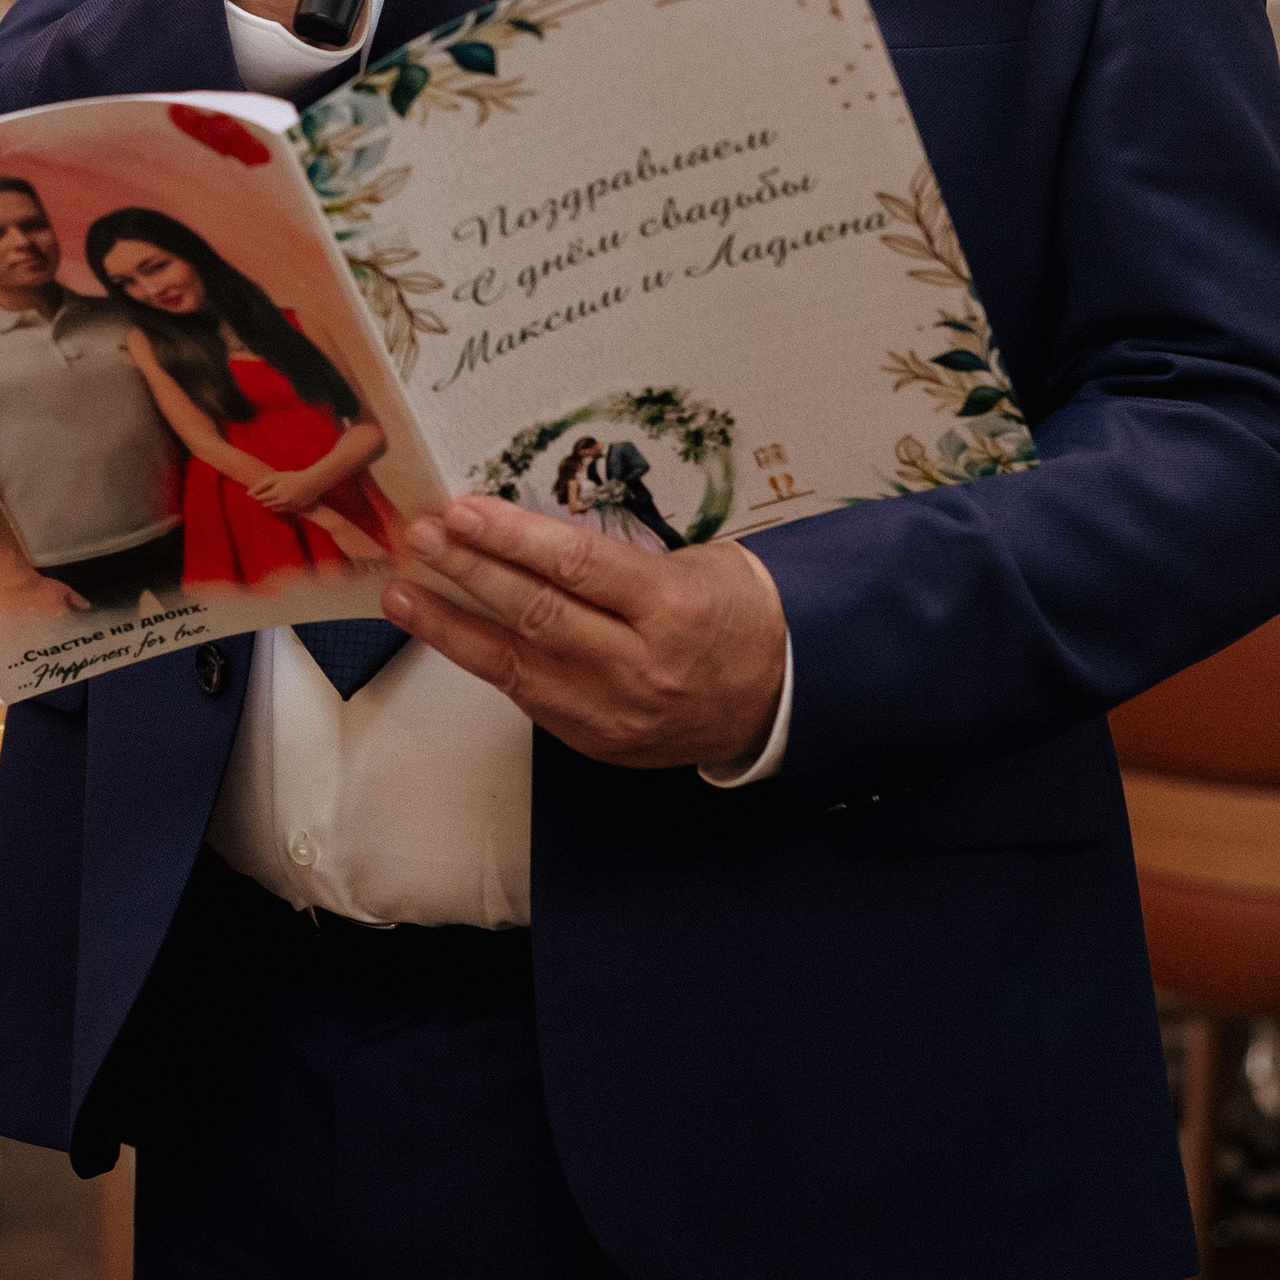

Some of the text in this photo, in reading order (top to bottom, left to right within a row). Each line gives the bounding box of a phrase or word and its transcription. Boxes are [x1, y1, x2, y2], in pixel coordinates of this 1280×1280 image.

[452, 128, 778, 246] Поздравляем
[452, 166, 817, 306] С днём свадьбы
[431, 286, 631, 392] Максим
[641, 270, 673, 294] и
[109, 621, 135, 636] на
[140, 604, 209, 629] двоих.
[133, 631, 167, 658] for
[173, 623, 210, 642] two.
